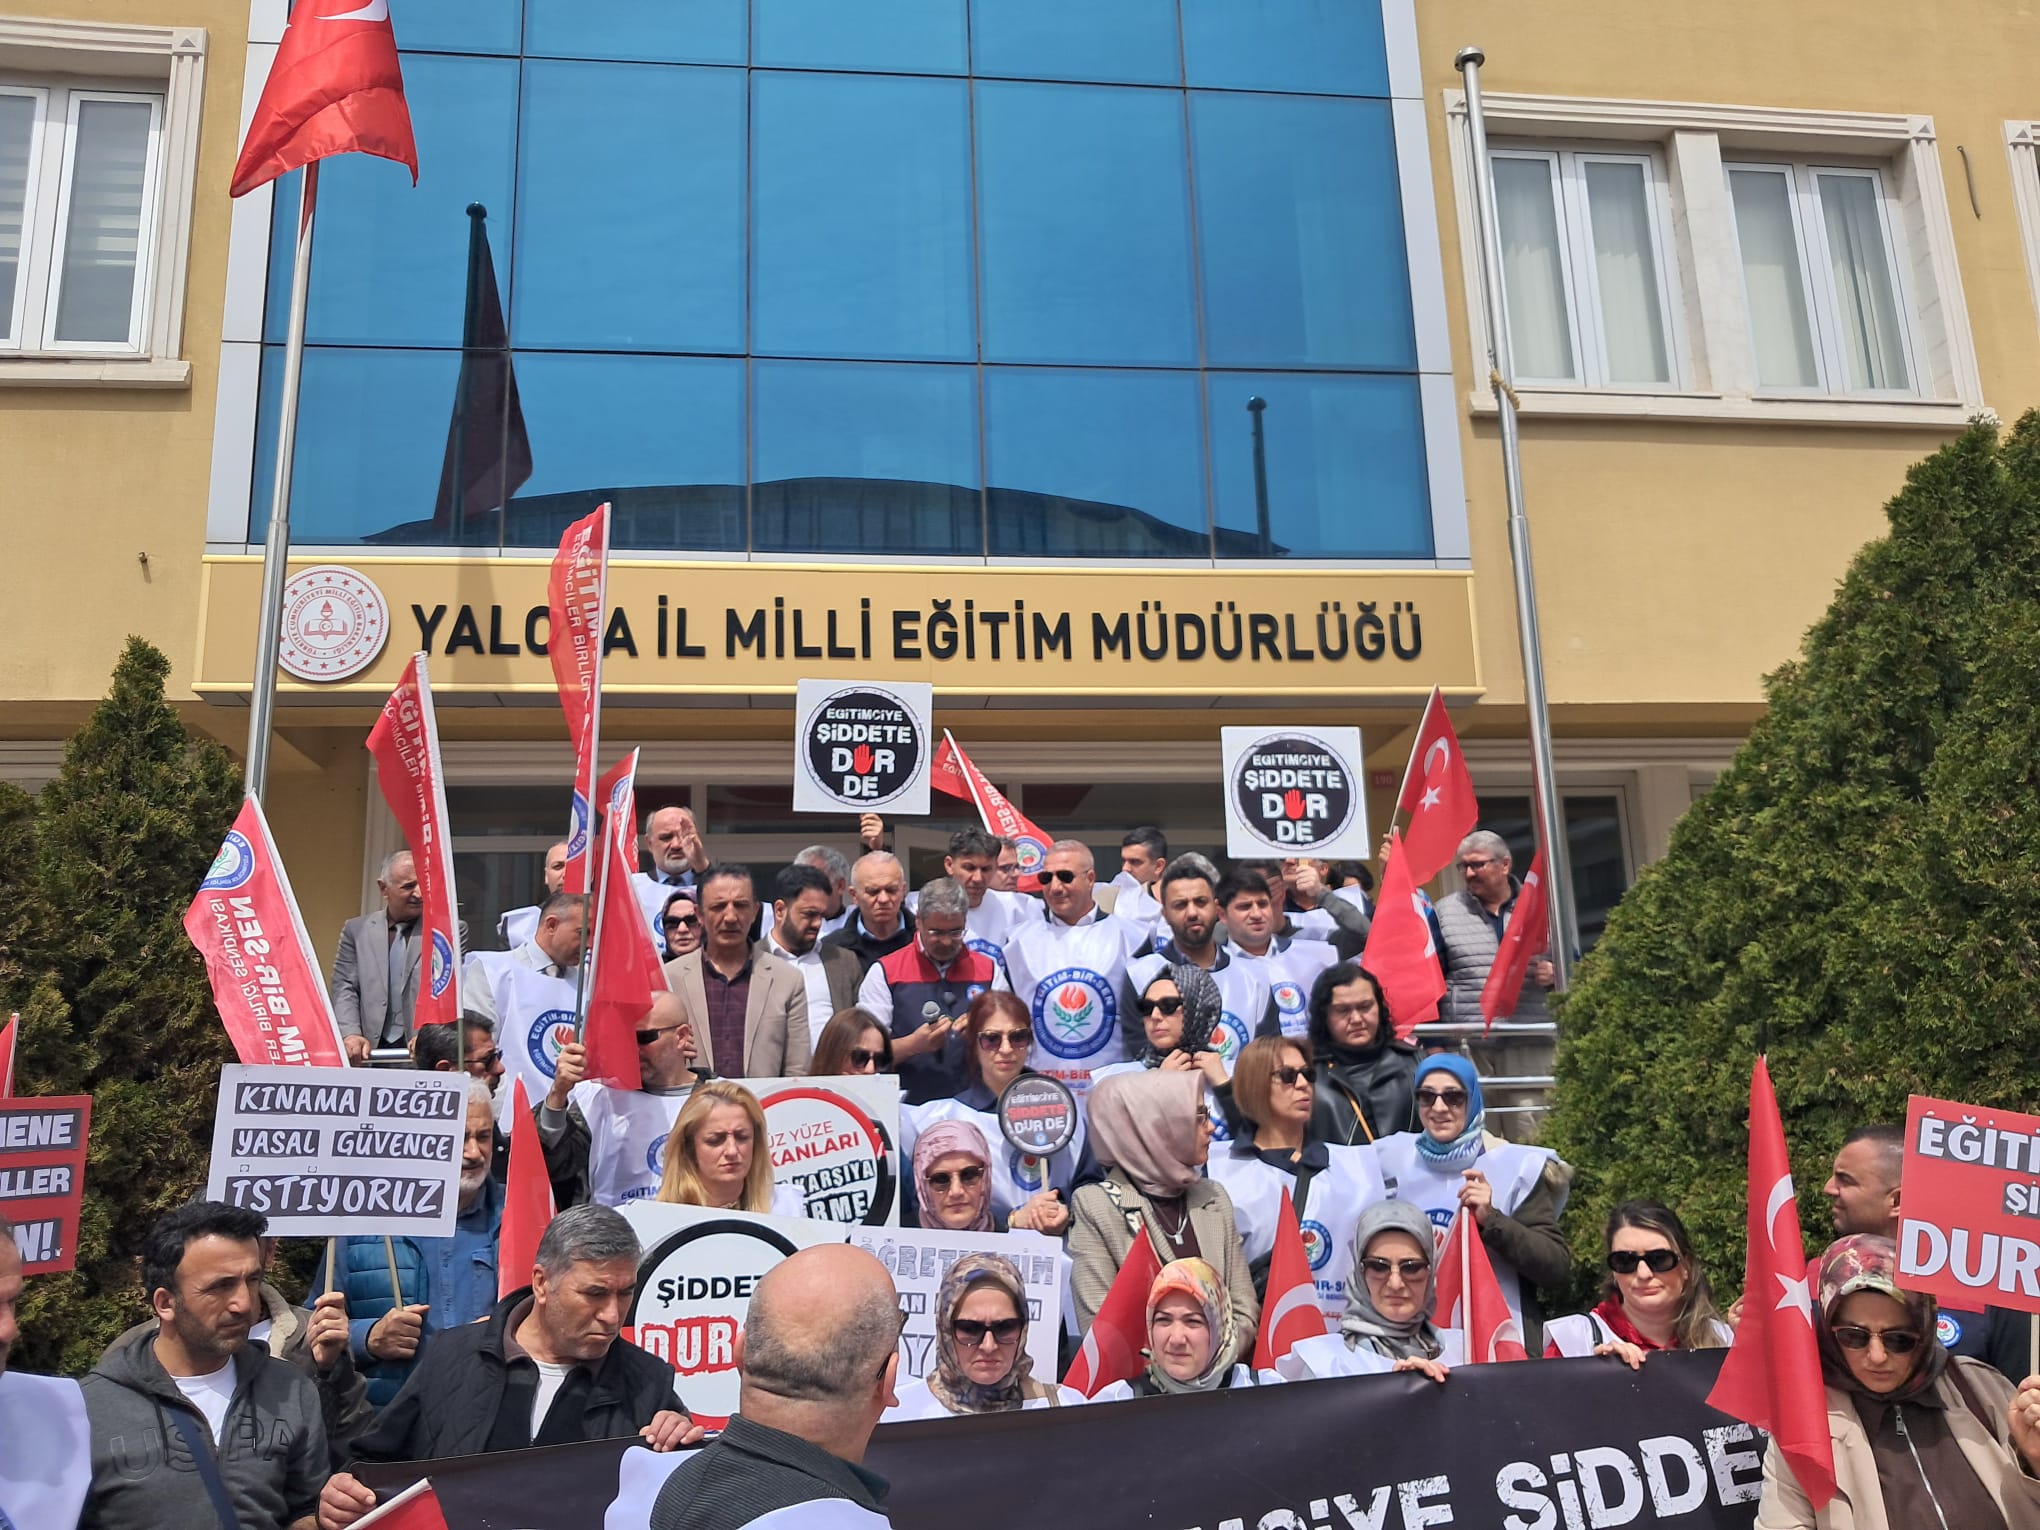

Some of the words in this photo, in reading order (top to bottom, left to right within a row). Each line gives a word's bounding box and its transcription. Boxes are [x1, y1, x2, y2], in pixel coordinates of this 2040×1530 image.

[411, 603, 639, 658] YALOA
[657, 595, 706, 658] İL
[725, 597, 872, 659] MİLLİ
[892, 598, 1072, 660] EĞİTİM
[1091, 600, 1423, 661] MÜDÜRLÜĞÜ
[843, 775, 879, 797] DE
[1276, 820, 1315, 842] DE
[238, 1085, 357, 1115] KINAMA
[376, 1080, 455, 1117] DEĞİL
[235, 1129, 316, 1156] YASAL
[336, 1122, 450, 1160] GÜVENCE
[789, 1120, 834, 1143] YÜZE
[1014, 1119, 1044, 1134] DUR
[1044, 1116, 1066, 1130] DE
[231, 1163, 443, 1214] İSTİYORUZ
[1899, 1217, 2040, 1299] DUR
[644, 1321, 734, 1369] DUR
